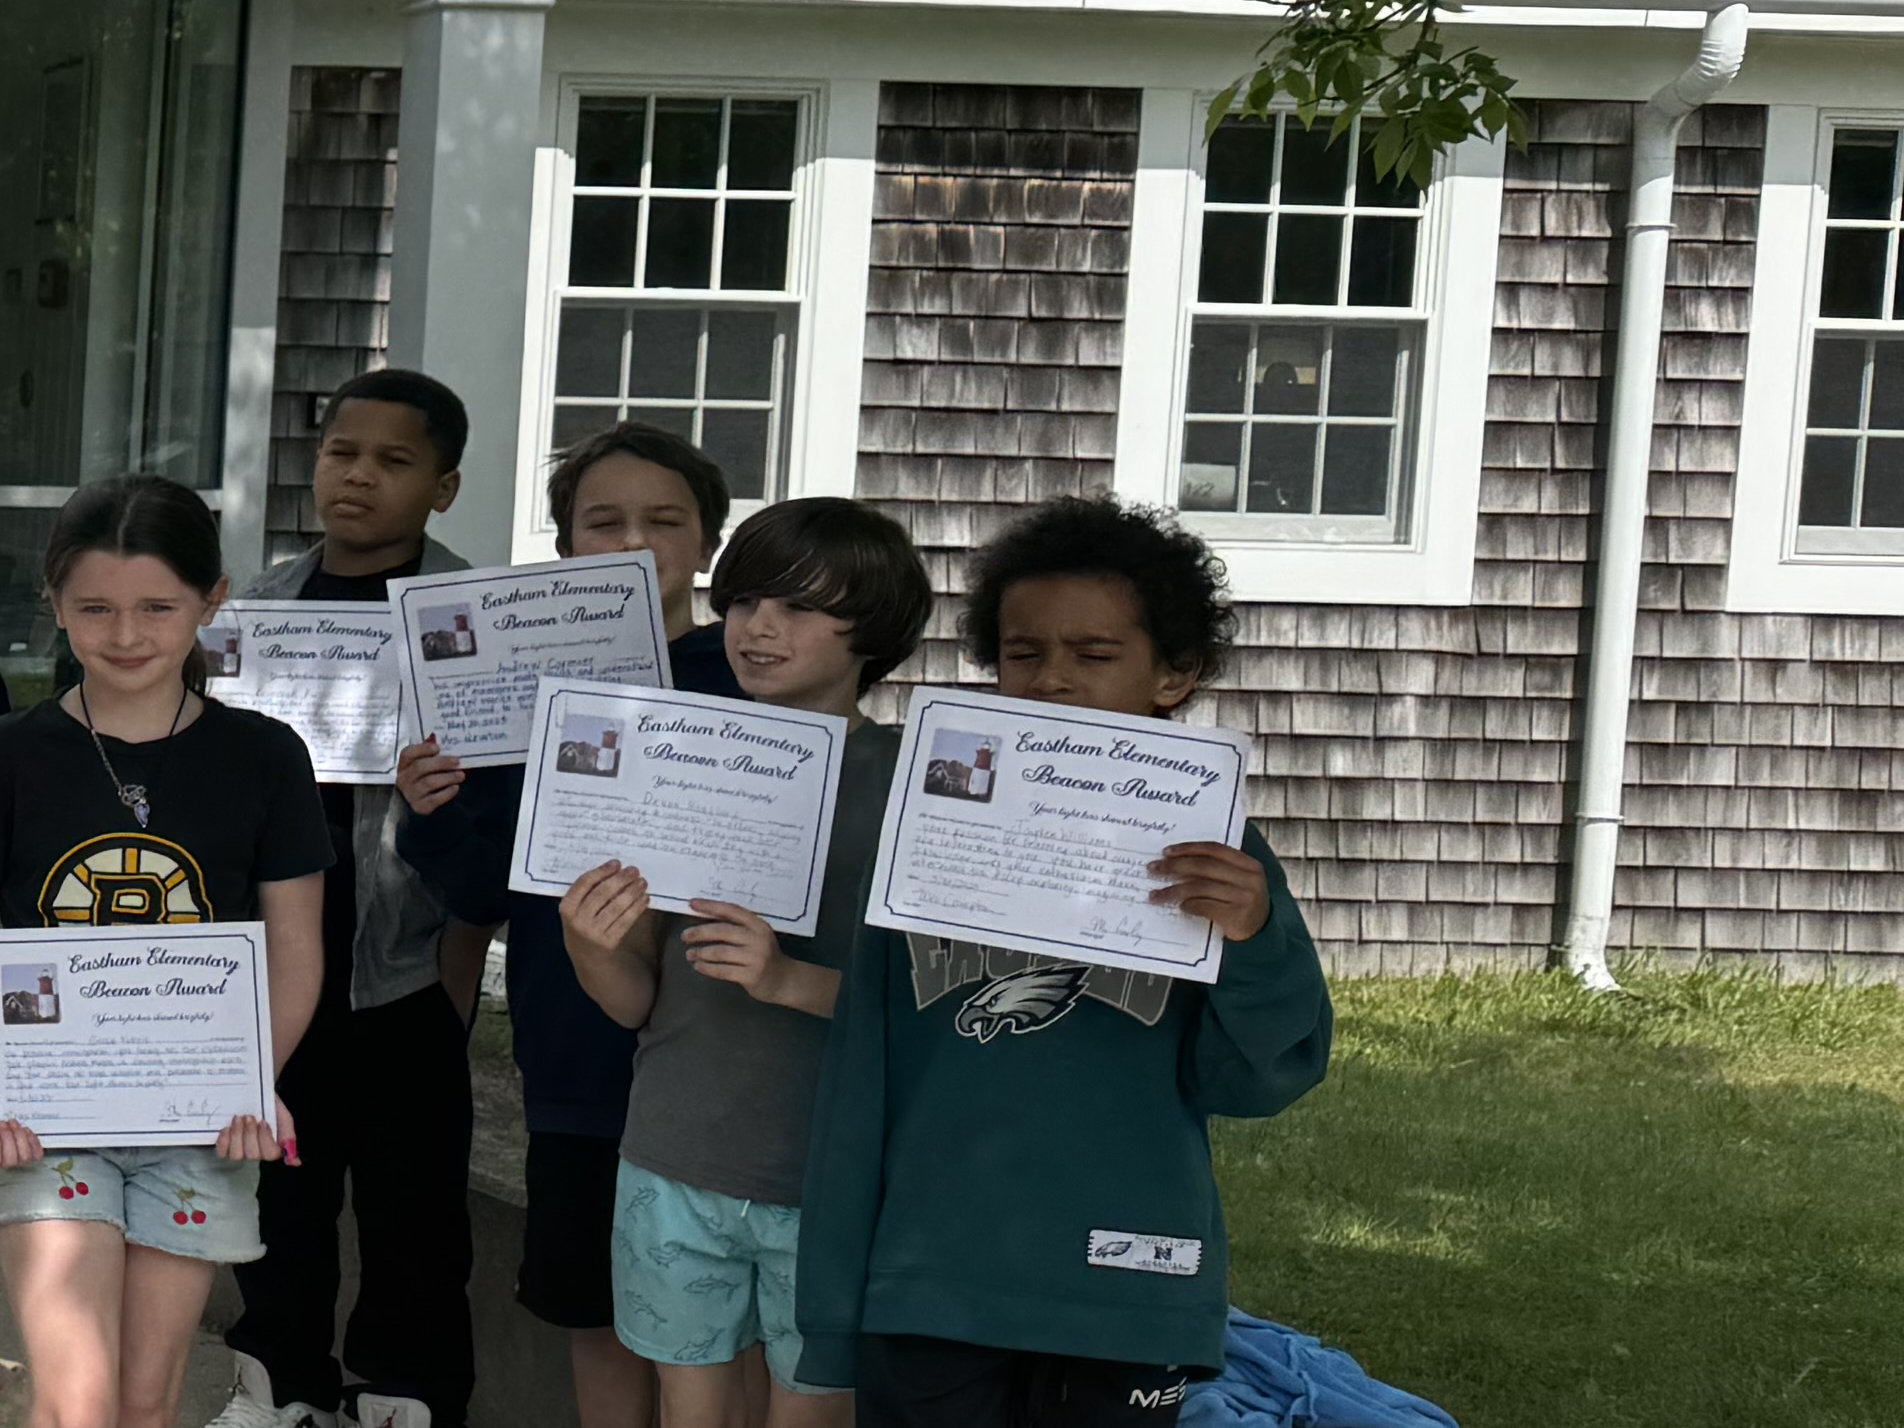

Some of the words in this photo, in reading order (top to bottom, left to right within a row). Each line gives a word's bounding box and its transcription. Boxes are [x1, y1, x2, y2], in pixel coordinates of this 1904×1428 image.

[482, 588, 546, 610] Eastham
[551, 581, 634, 601] Elementary
[493, 614, 558, 630] Beacon
[562, 603, 625, 623] Award
[638, 715, 713, 735] Eastham
[720, 722, 814, 763] Elementary
[644, 743, 718, 767] Beacon
[723, 756, 797, 780] Award
[1016, 732, 1102, 756] Eastham
[1109, 738, 1220, 787] Elementary
[1022, 765, 1105, 792] Beacon
[1112, 778, 1200, 806] Award
[70, 953, 141, 973] Eastham
[147, 947, 239, 975] Elementary
[80, 981, 151, 998] Beacon
[156, 978, 227, 995] Award
